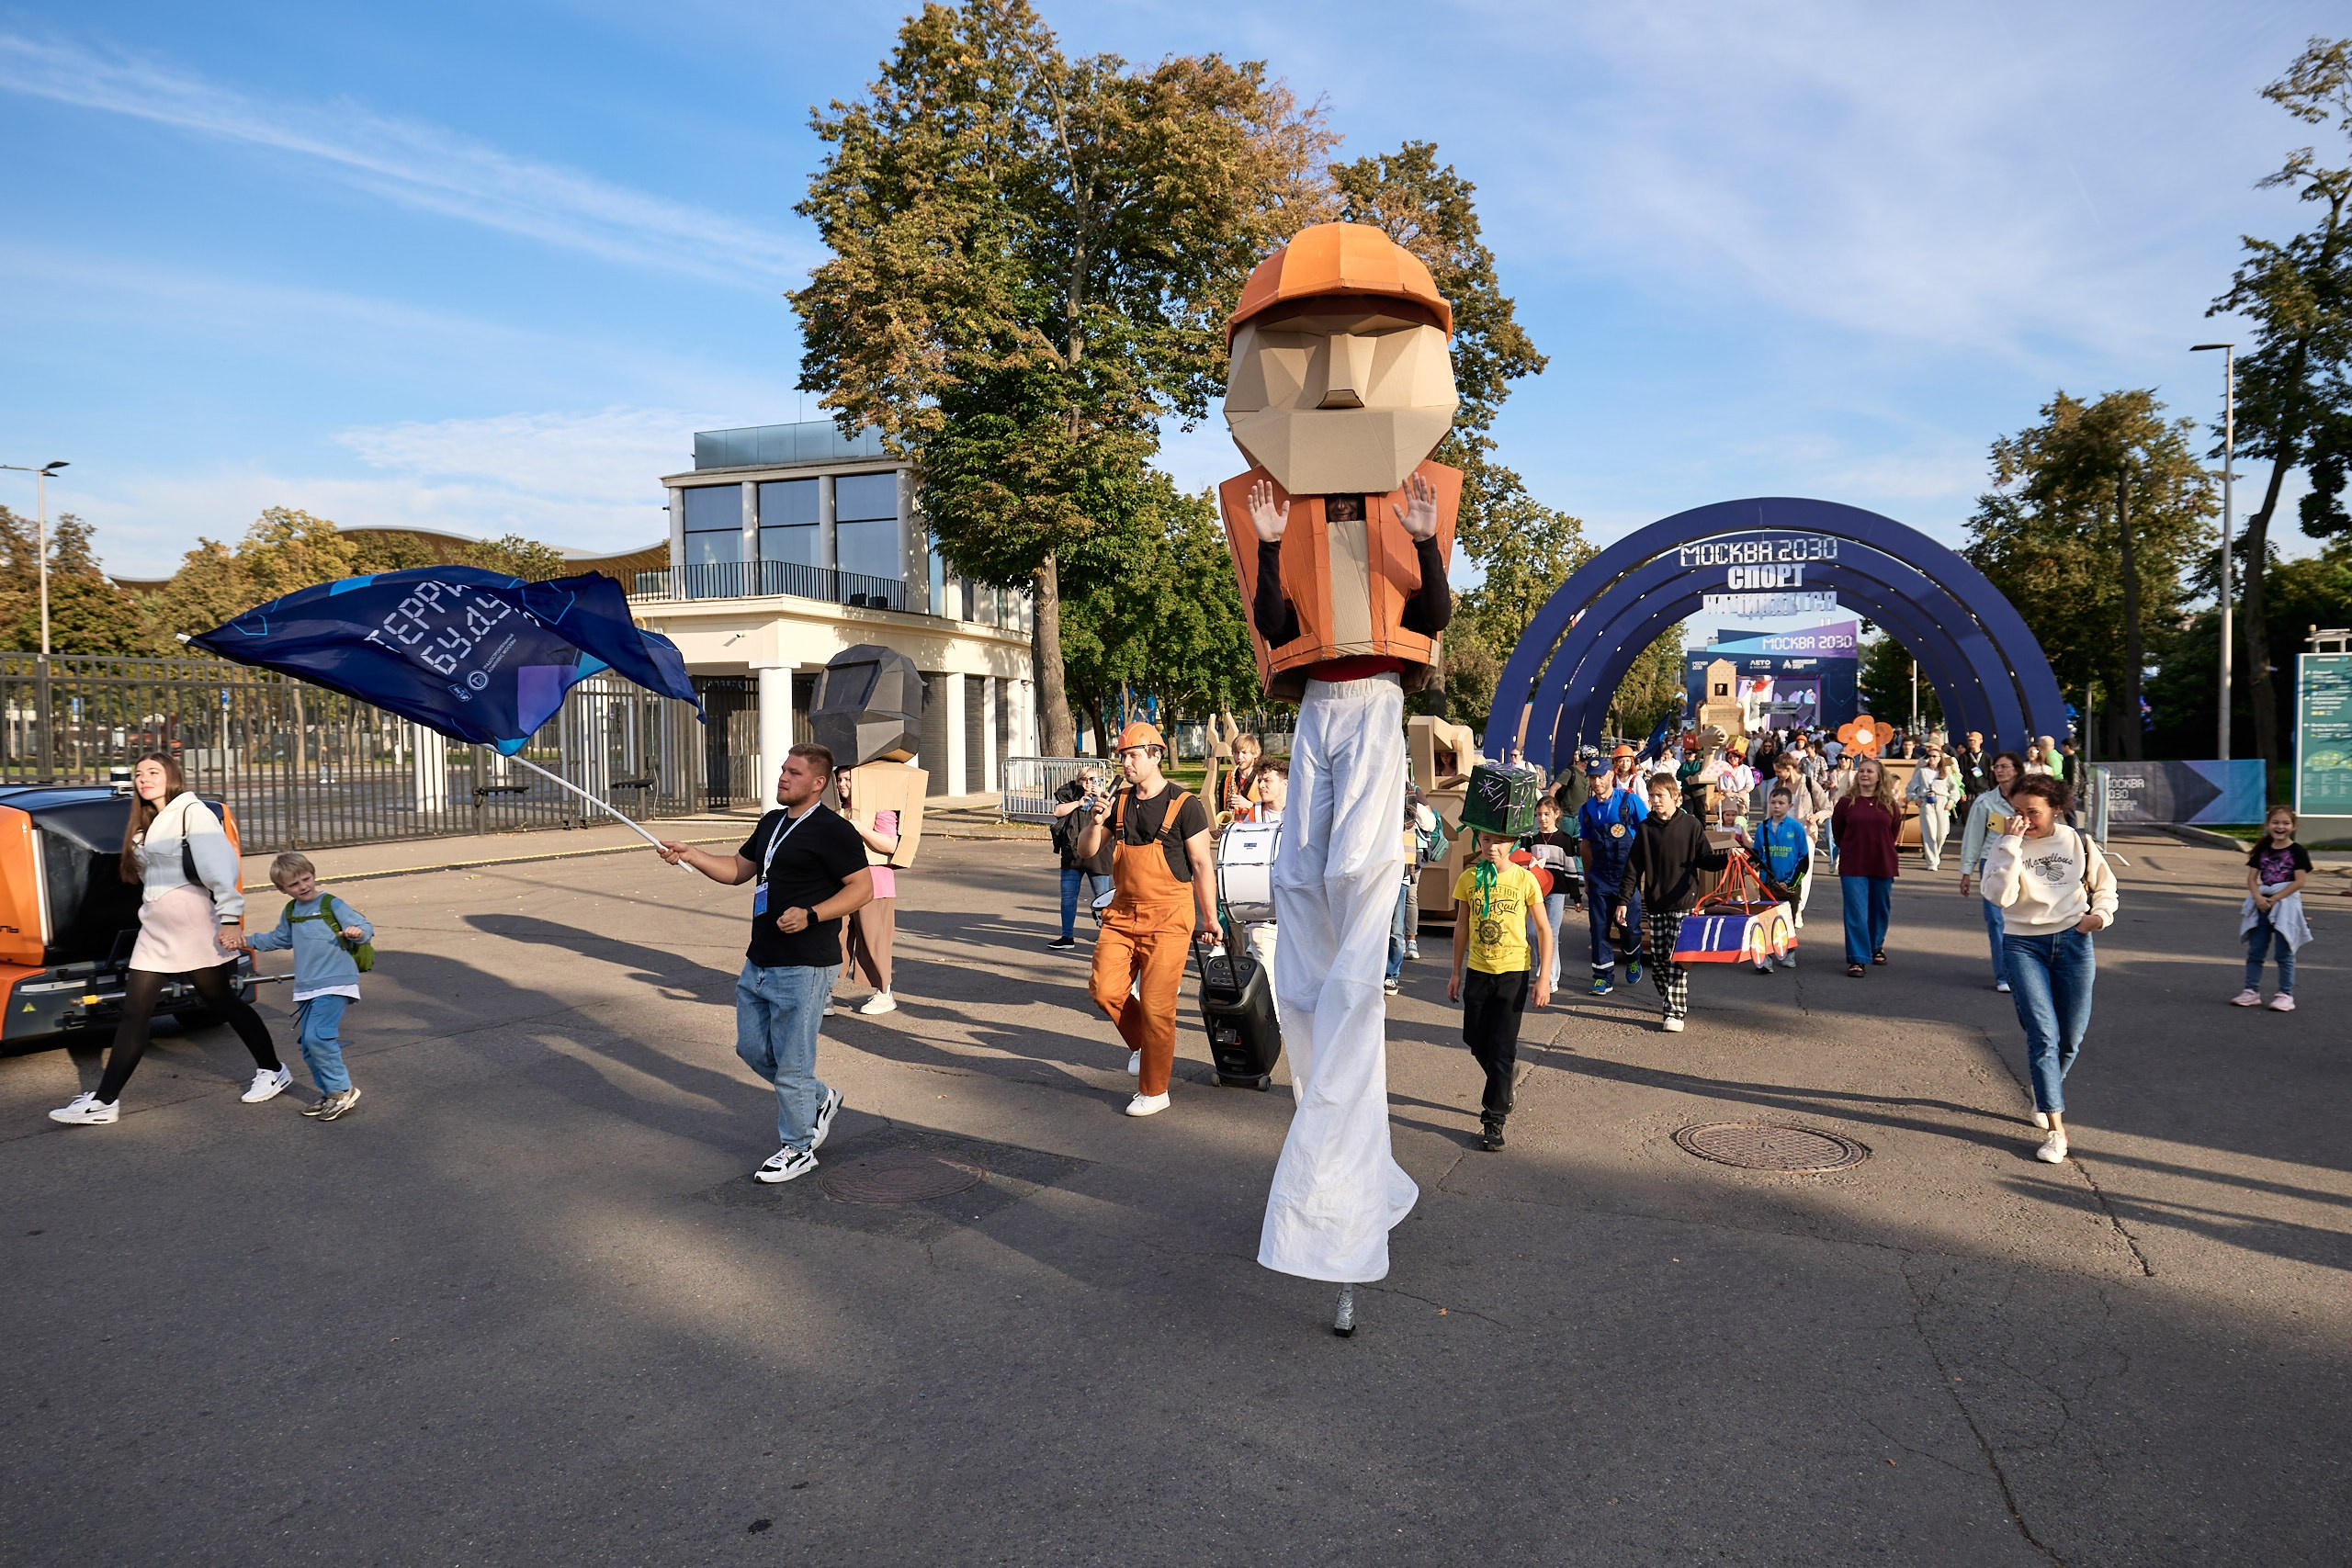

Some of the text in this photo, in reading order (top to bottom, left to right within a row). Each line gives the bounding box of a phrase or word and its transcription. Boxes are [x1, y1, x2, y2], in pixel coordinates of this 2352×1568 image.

[1680, 537, 1838, 566] МОСКВА 2030
[1727, 563, 1806, 590] СПОРТ
[1762, 635, 1853, 650] МОСКВА 2030
[2109, 790, 2129, 799] 030
